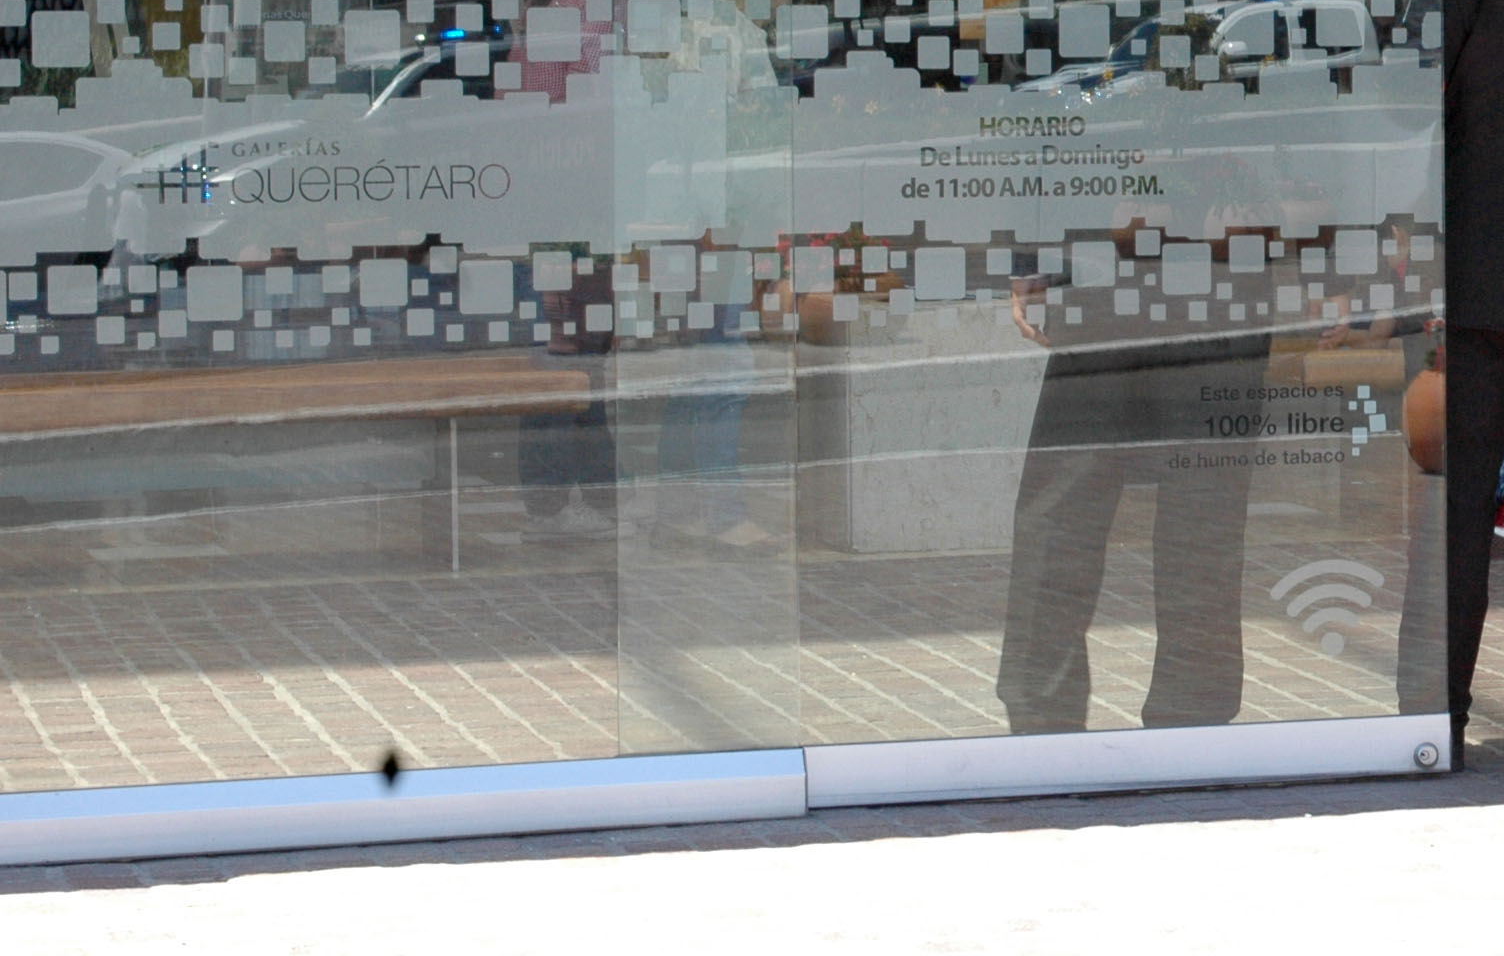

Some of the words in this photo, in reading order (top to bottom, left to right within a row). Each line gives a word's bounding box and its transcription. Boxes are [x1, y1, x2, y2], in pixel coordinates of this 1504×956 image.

[979, 115, 1086, 137] HORARIO
[920, 146, 951, 166] De
[955, 145, 1021, 166] Lunes
[1024, 150, 1038, 165] a
[1042, 144, 1145, 170] Domingo
[901, 177, 930, 198] de
[935, 178, 996, 198] 11:00
[999, 176, 1049, 197] A.M.
[1053, 181, 1066, 196] a
[1070, 175, 1117, 196] 9:00
[1121, 174, 1164, 196] P.M.
[1200, 386, 1241, 402] Este
[1248, 382, 1318, 402] espacio
[1323, 384, 1345, 397] es
[1204, 413, 1277, 437] 100%
[1287, 412, 1345, 435] libre
[1168, 453, 1190, 469] de
[1197, 453, 1249, 468] humo
[1255, 450, 1278, 466] de
[1283, 448, 1346, 465] tabaco
